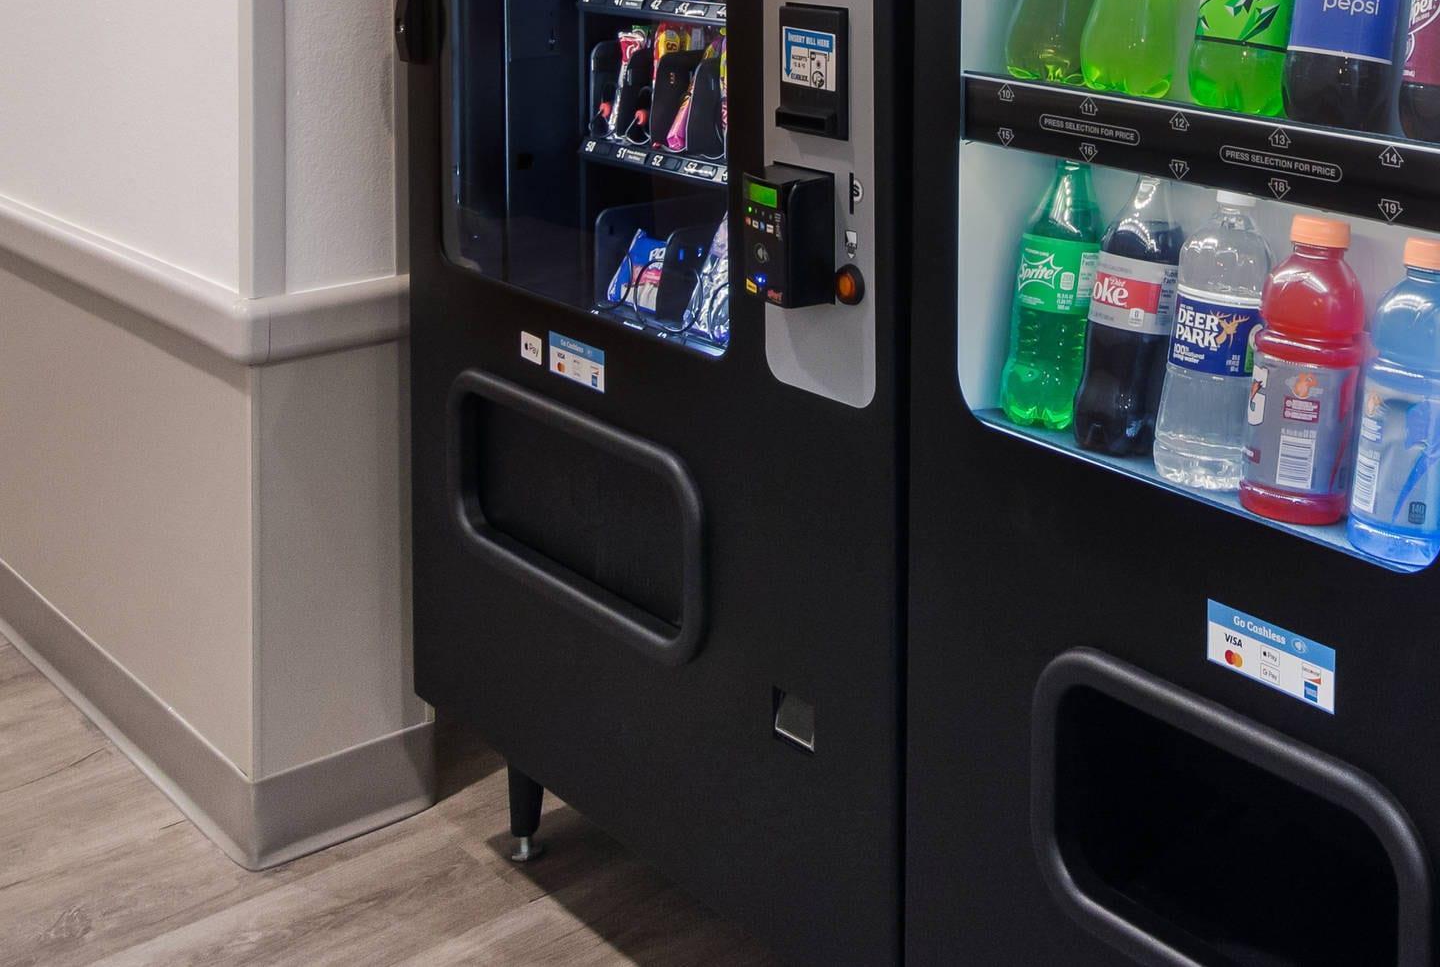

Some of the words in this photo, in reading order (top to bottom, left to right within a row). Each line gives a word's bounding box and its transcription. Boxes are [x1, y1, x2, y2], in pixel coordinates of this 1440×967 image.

[1002, 89, 1011, 99] 10
[1084, 103, 1093, 113] 11
[1174, 118, 1185, 128] 12
[1002, 130, 1011, 140] 15
[1044, 118, 1065, 129] PRESS
[1065, 121, 1100, 135] SELECTION
[1100, 127, 1114, 138] FOR
[1115, 130, 1135, 141] PRICE
[1274, 133, 1286, 145] 13
[1084, 145, 1093, 156] 16
[1225, 150, 1250, 162] PRESS
[1251, 154, 1293, 170] SELECTION
[1294, 161, 1311, 173] FOR
[1312, 165, 1336, 178] PRICE
[1385, 152, 1397, 164] 14
[1174, 162, 1184, 173] 17
[1274, 181, 1285, 193] 18
[1385, 202, 1397, 214] 19
[1019, 263, 1054, 281] Sprite
[1178, 307, 1219, 332] DEER
[1175, 324, 1220, 349] PARK
[1233, 615, 1246, 628] Go
[1247, 621, 1286, 645] Cashless
[1224, 633, 1243, 648] VISA
